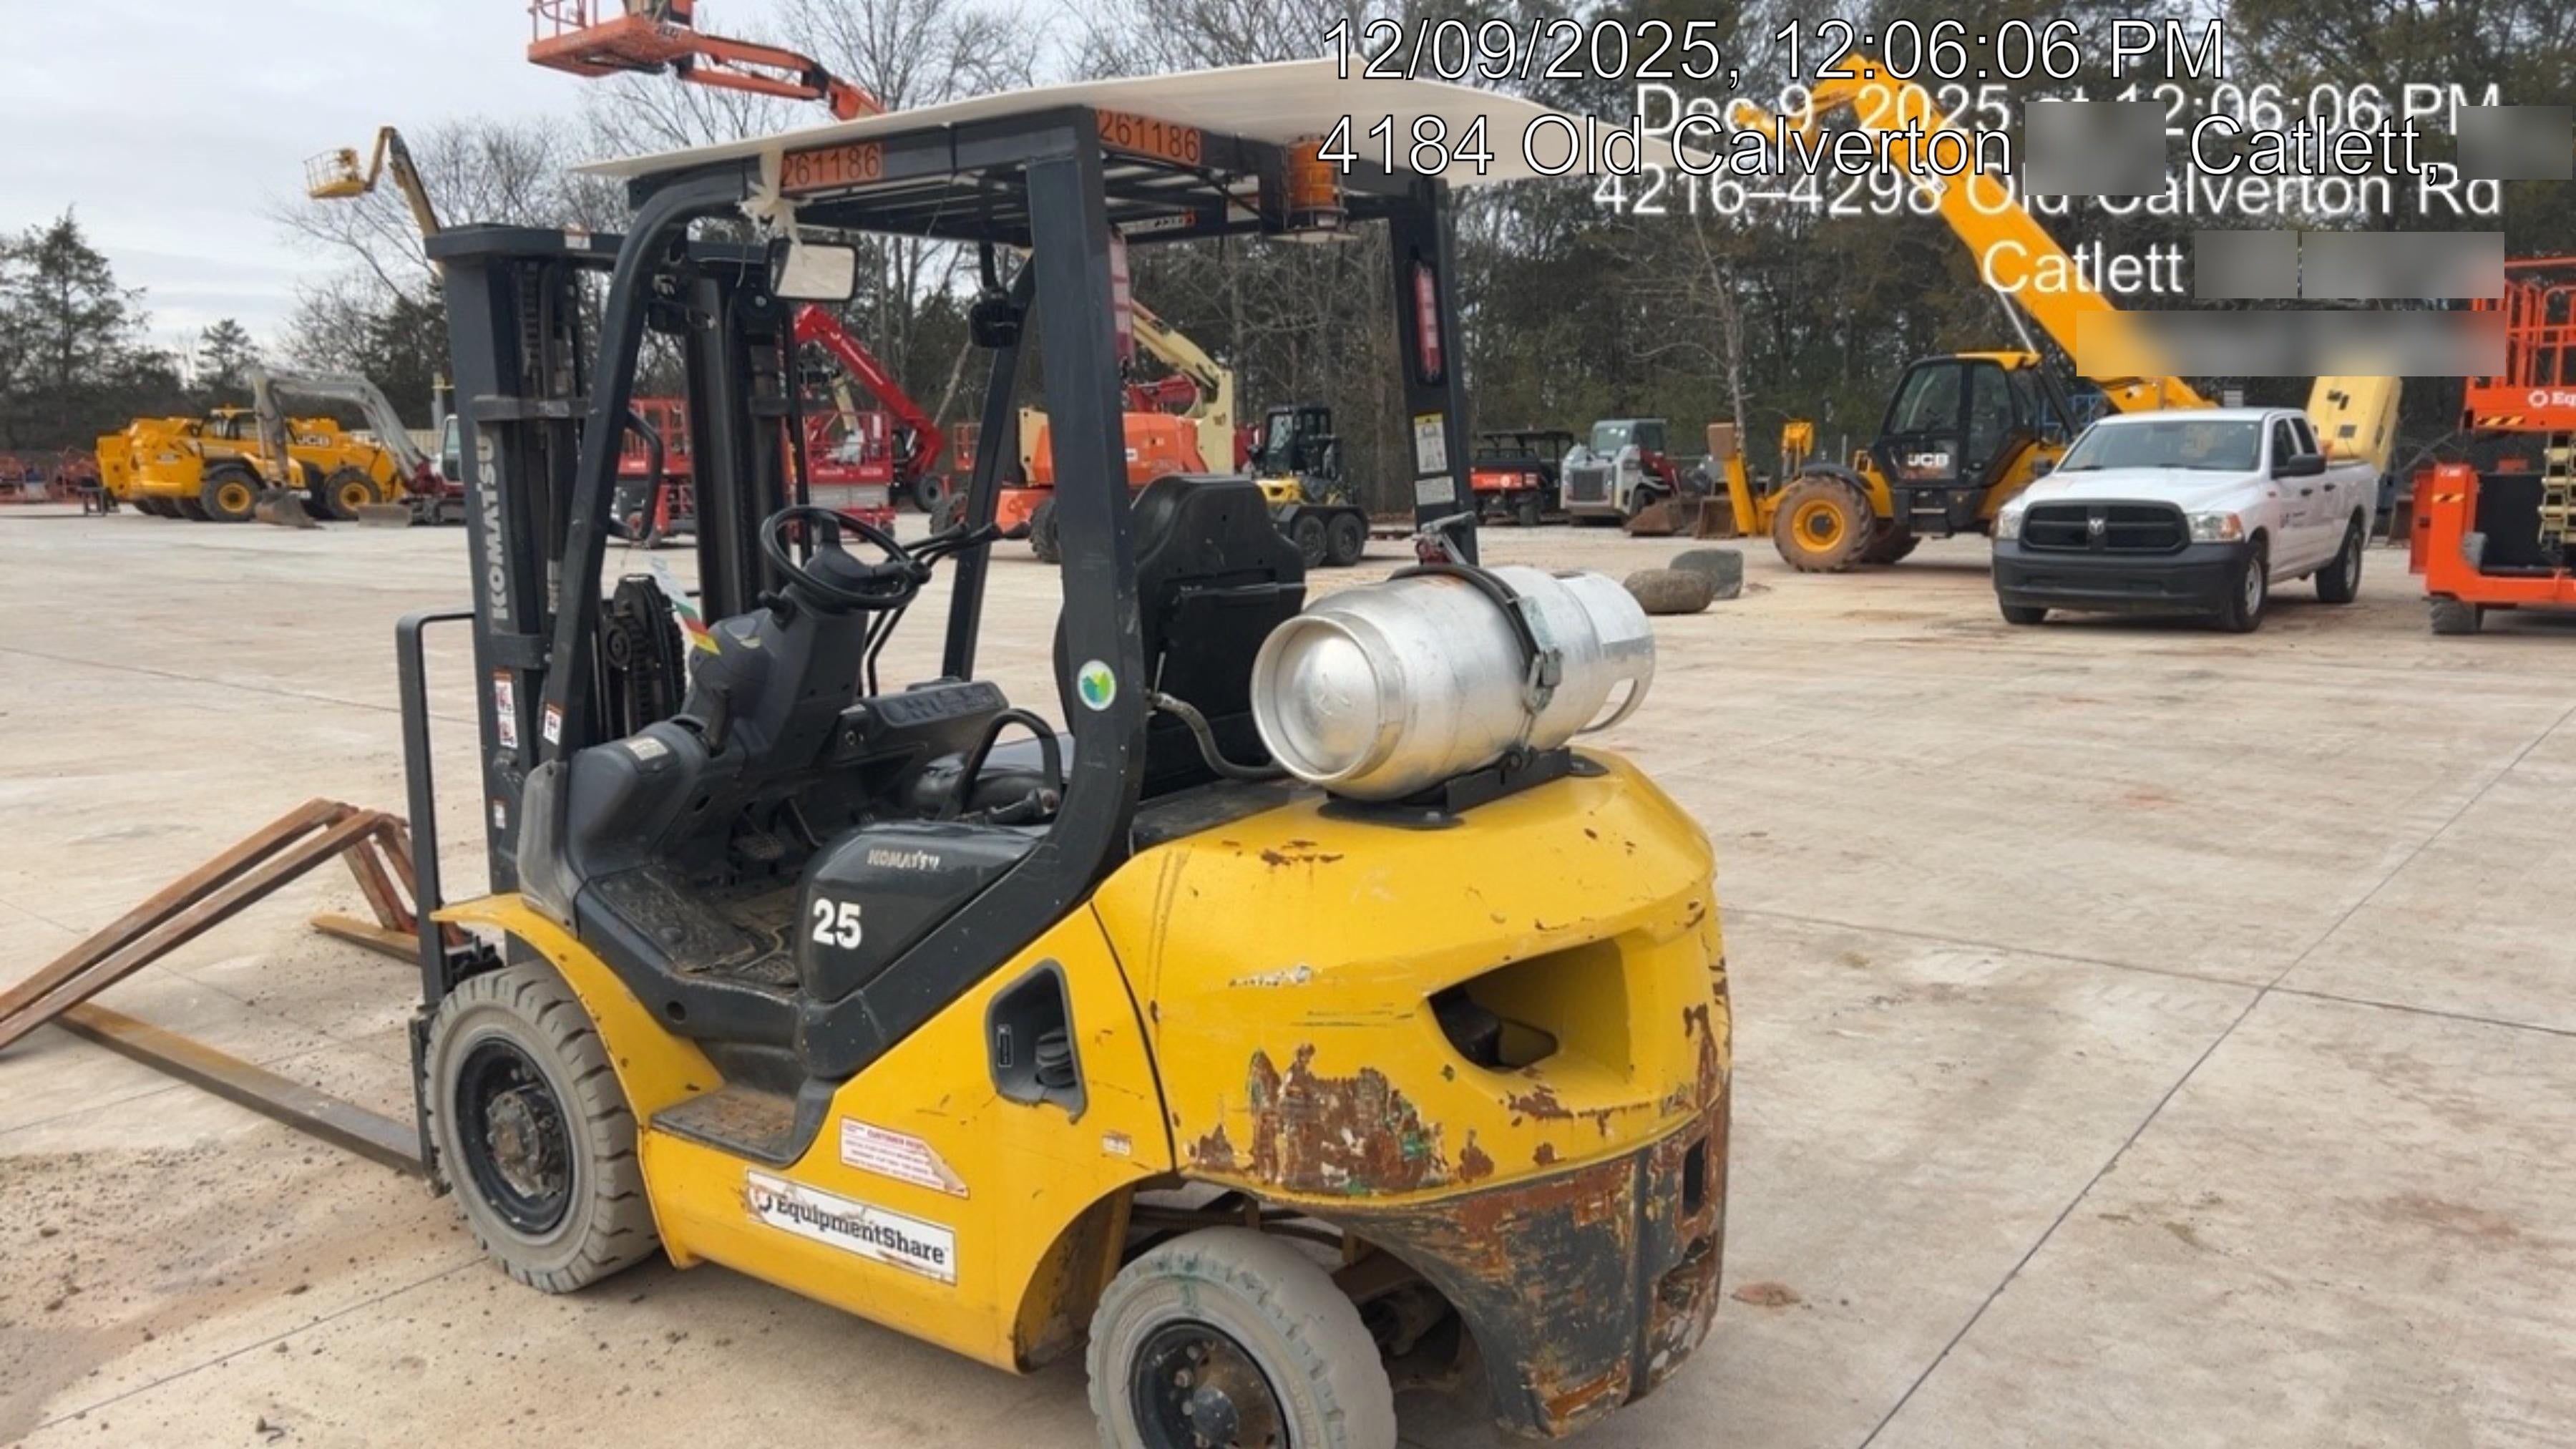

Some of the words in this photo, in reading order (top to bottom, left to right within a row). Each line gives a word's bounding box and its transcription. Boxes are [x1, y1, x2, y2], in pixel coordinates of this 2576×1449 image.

[1097, 110, 1199, 162] 261186
[781, 143, 879, 187] 261186
[1907, 452, 1949, 467] JCB
[475, 434, 509, 620] KOMATSU
[812, 897, 862, 950] 25
[776, 1194, 946, 1265] EquipmentShare
